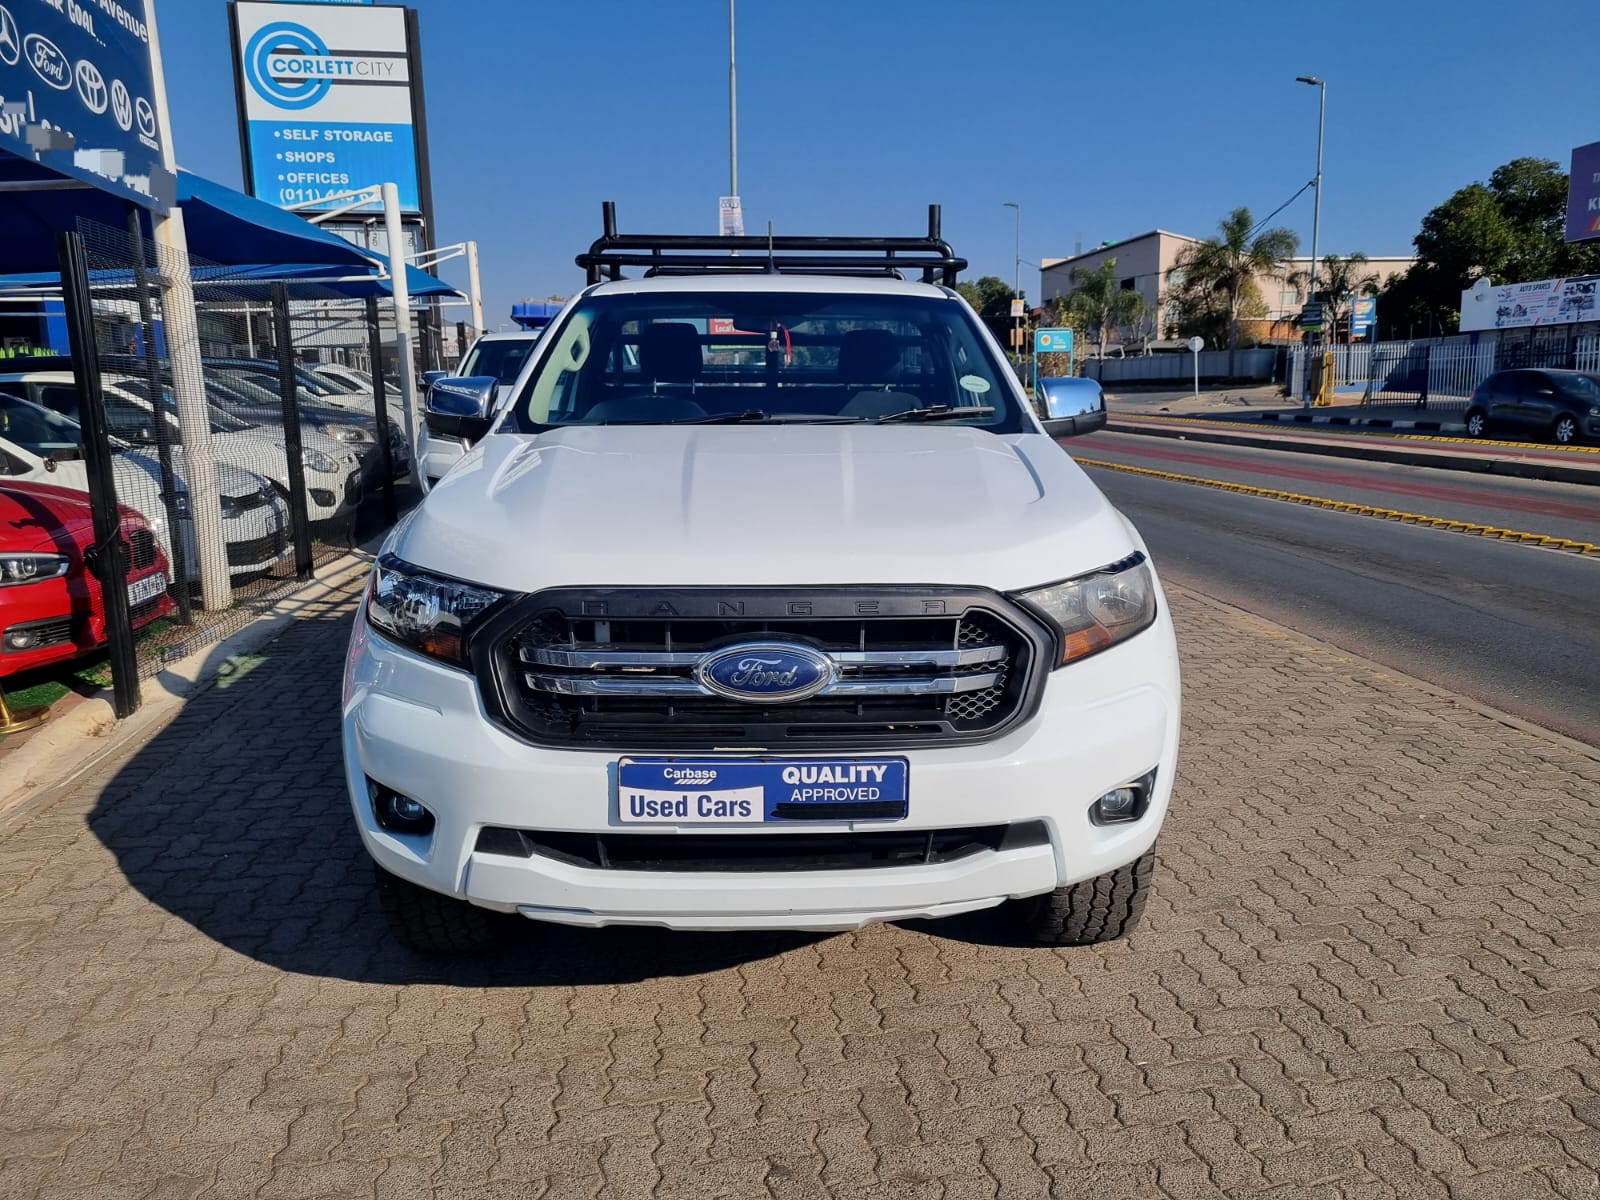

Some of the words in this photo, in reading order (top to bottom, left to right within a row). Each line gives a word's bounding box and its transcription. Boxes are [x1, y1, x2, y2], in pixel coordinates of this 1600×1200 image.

[99, 0, 148, 43] Avenue
[33, 41, 65, 81] Ford
[272, 58, 353, 75] CORLETT
[356, 61, 394, 76] CITY
[283, 129, 319, 140] SELF
[323, 130, 393, 143] STORAGE
[285, 152, 335, 163] SHOPS
[286, 172, 350, 184] OFFICES
[279, 187, 320, 203] (011)
[581, 599, 947, 616] RANGER
[730, 657, 799, 689] Ford
[663, 768, 717, 778] Carbase
[782, 766, 886, 785] QUALITY
[790, 787, 881, 803] APPROVED
[630, 794, 689, 818] Used
[697, 794, 752, 818] Cars
